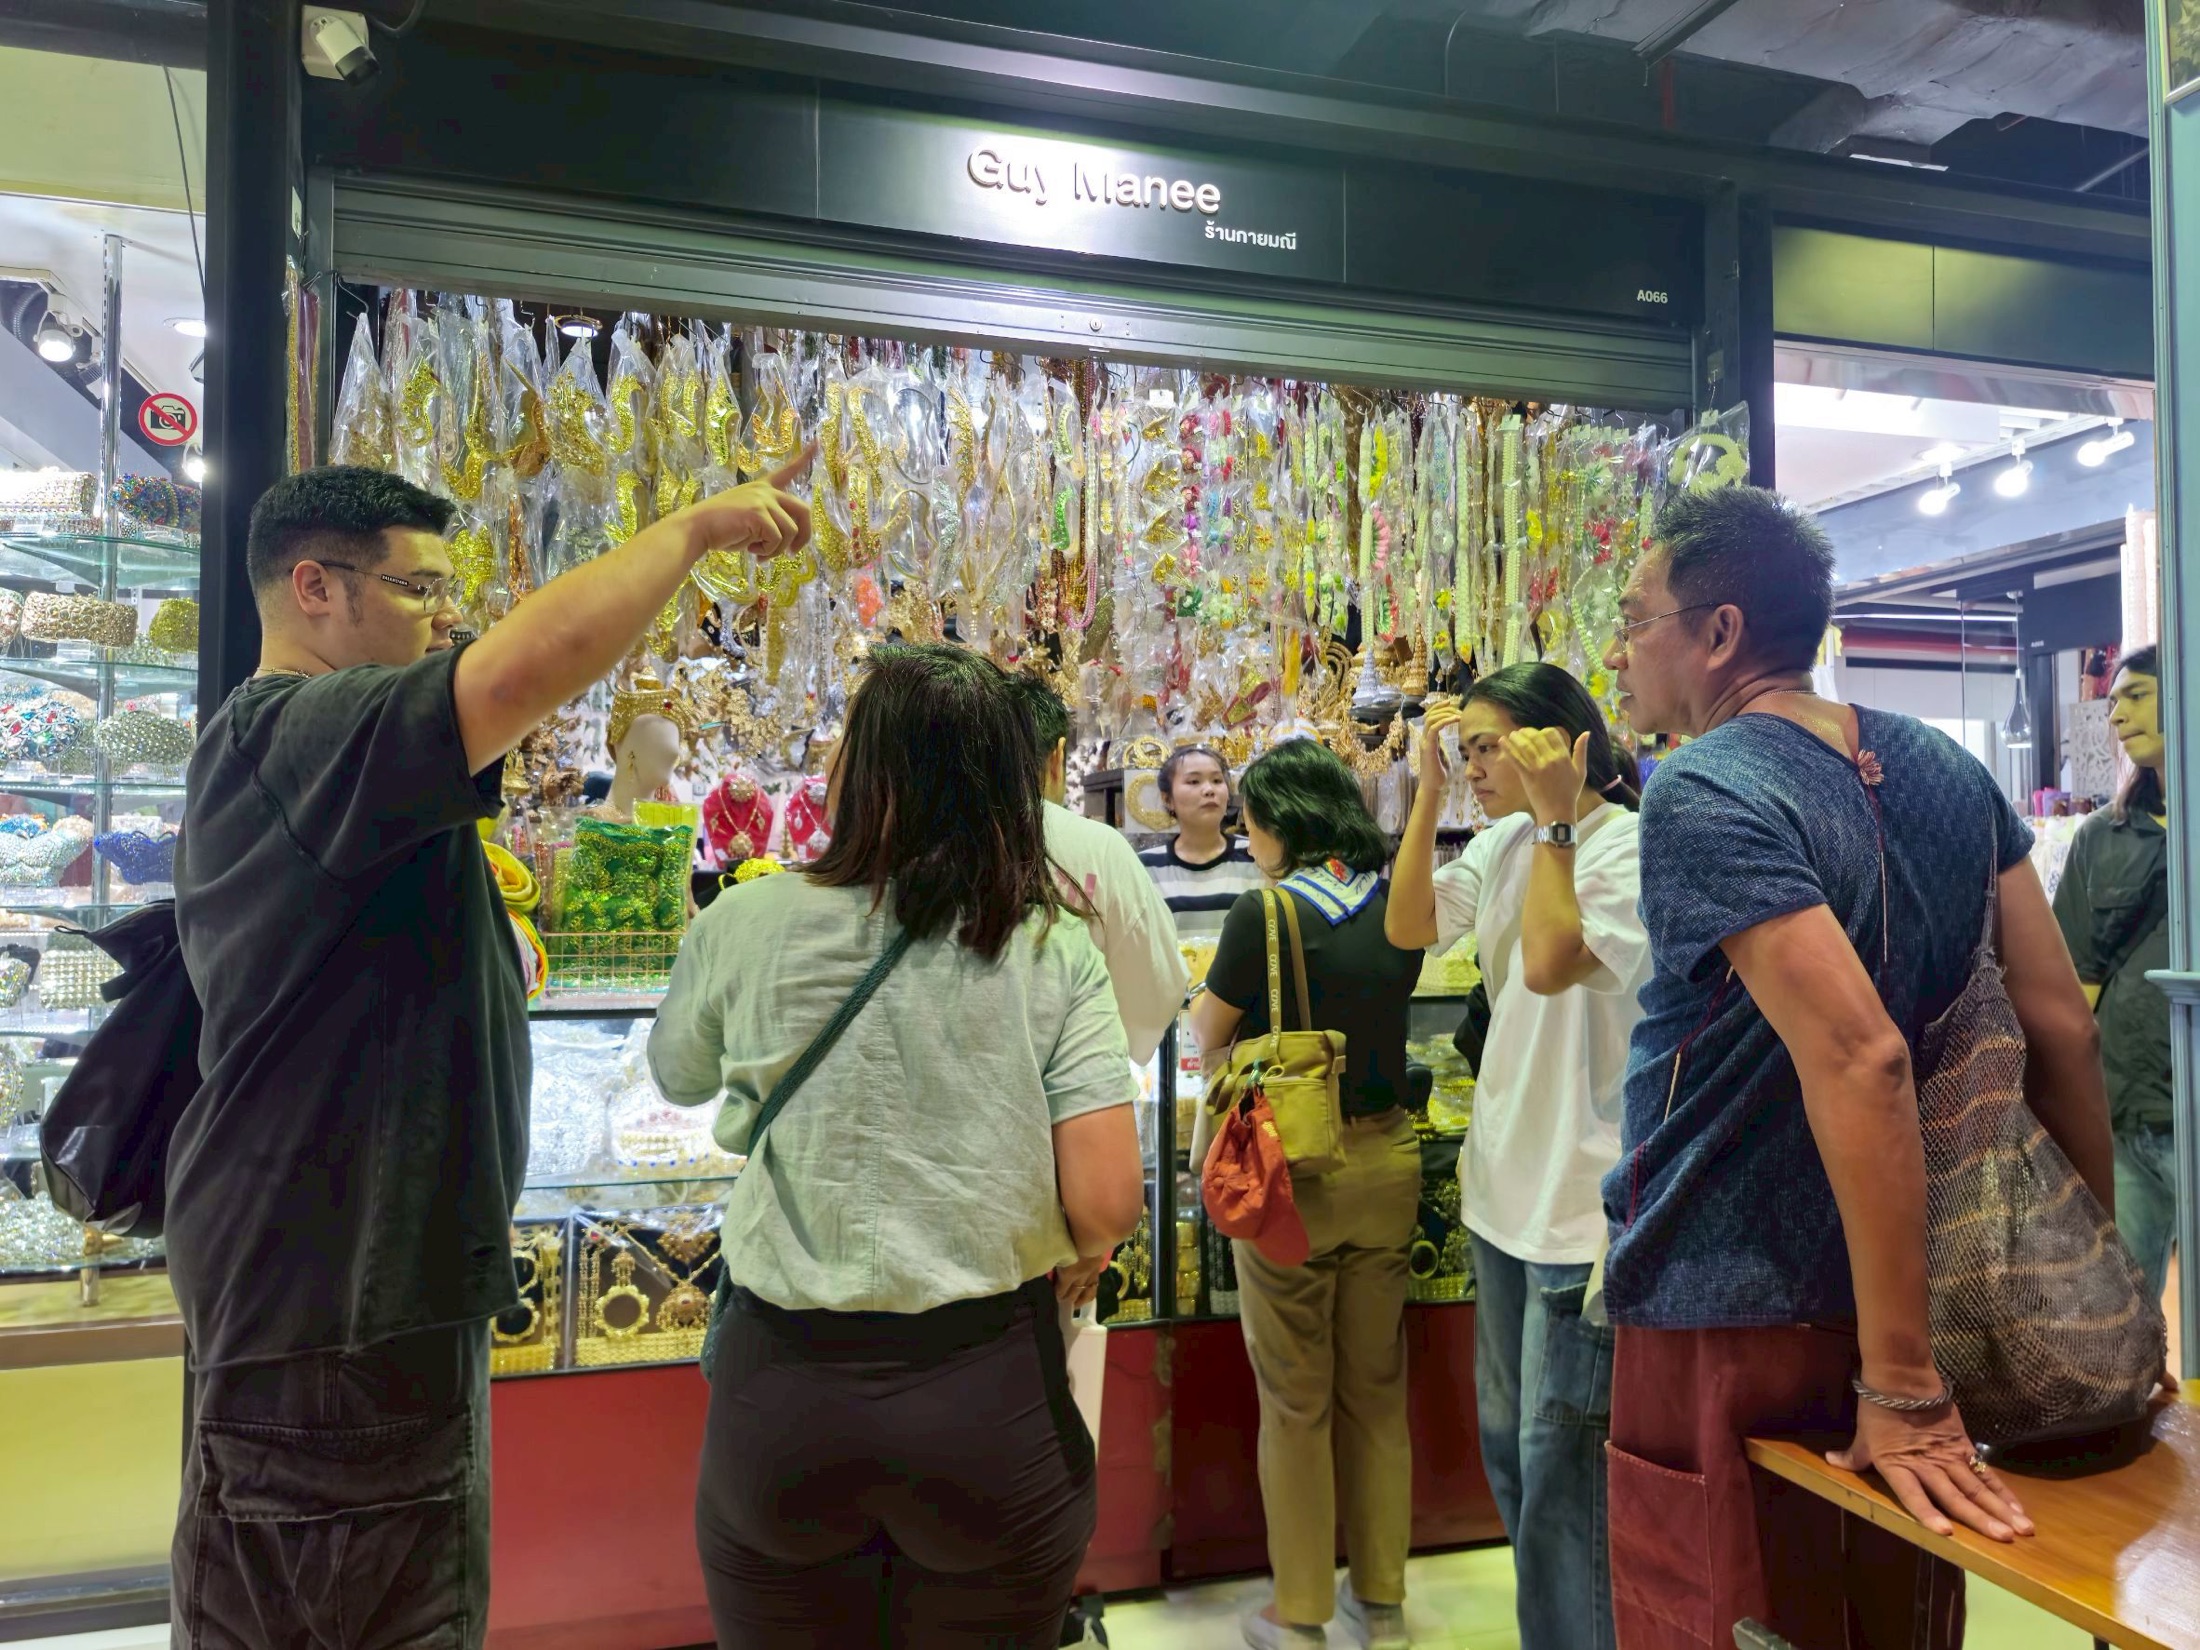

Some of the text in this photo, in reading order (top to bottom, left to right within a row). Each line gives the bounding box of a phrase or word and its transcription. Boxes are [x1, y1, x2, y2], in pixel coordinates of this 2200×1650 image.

[967, 147, 1221, 215] Guy Manee
[1204, 220, 1297, 250] ร้านกายมณี
[1637, 289, 1668, 304] A066
